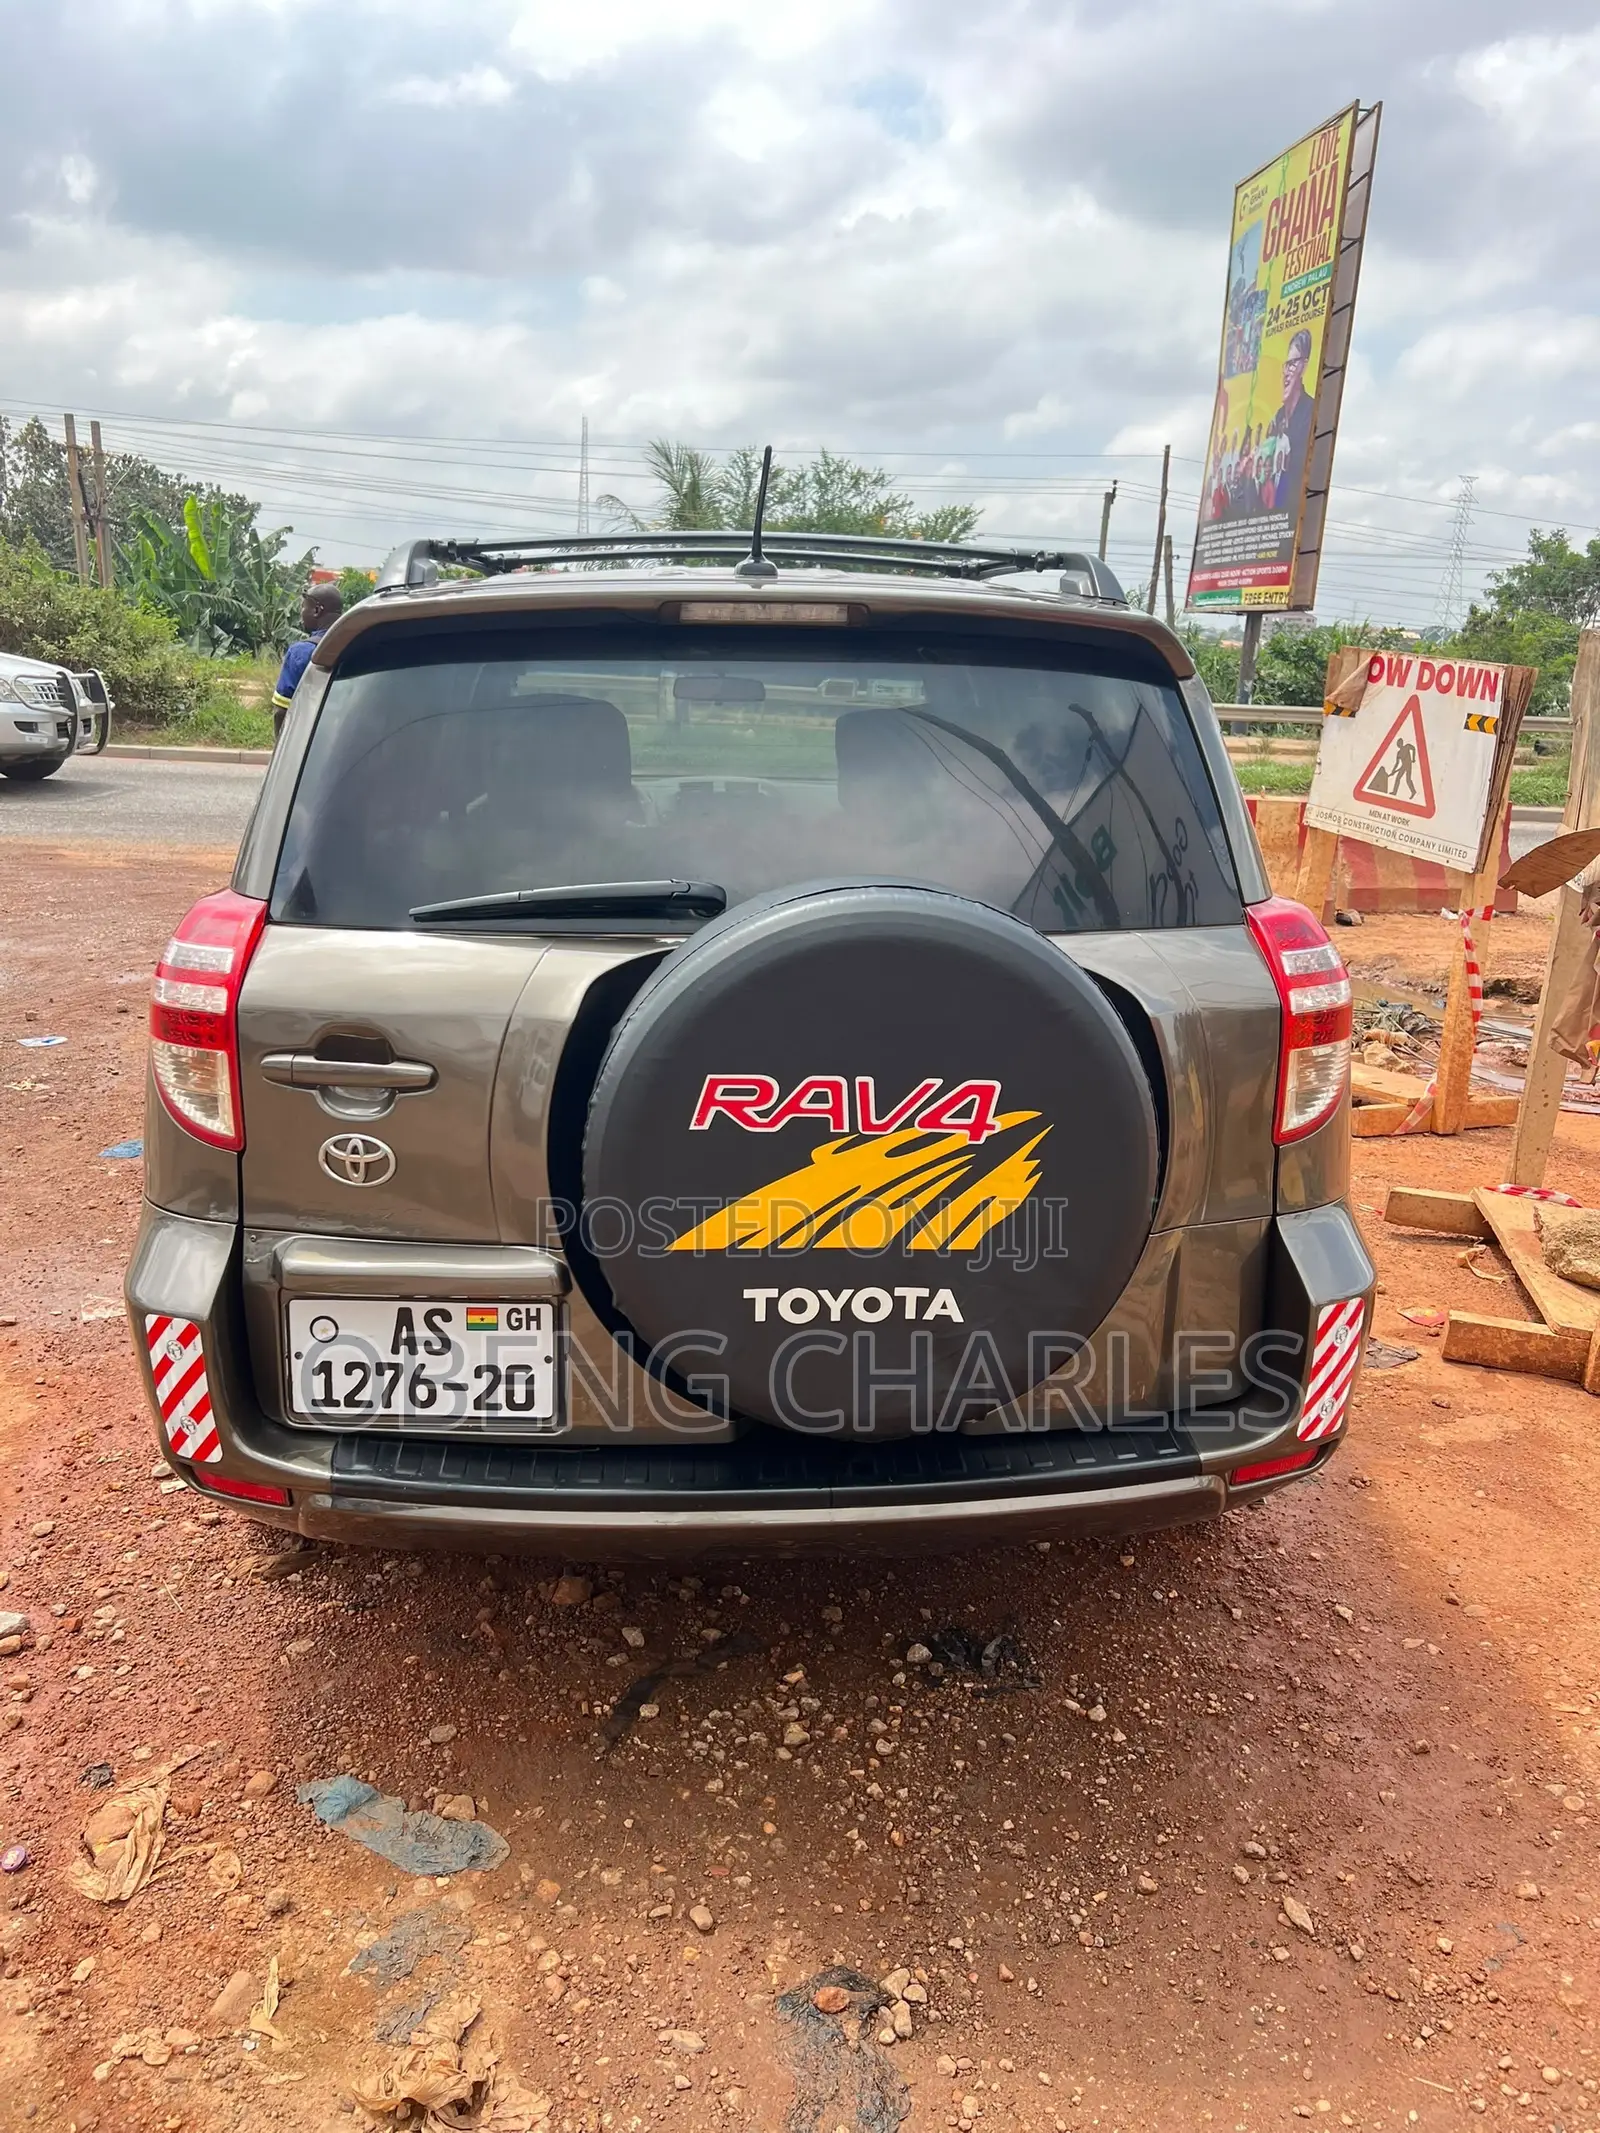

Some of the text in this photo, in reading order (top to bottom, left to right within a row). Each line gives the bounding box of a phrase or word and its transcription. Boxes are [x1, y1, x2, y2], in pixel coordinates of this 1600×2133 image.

[1309, 125, 1341, 176] LOVE
[1262, 160, 1339, 263] GHANA
[1283, 229, 1332, 282] FESTIVAL
[1285, 316, 1300, 331] RACE
[1300, 305, 1325, 324] COURSE
[1302, 282, 1330, 311] OCT
[1244, 592, 1262, 605] FREE
[1263, 591, 1288, 604] ENTRY
[1367, 655, 1499, 703] OW DOWN
[1343, 817, 1397, 838] CONSTRUCTION
[1398, 833, 1437, 850] COMPANY
[1437, 844, 1468, 859] LIMITED
[1368, 809, 1411, 827] MEN AT WORK
[689, 1074, 1001, 1144] RAV4
[743, 1286, 965, 1325] TOYOTA
[390, 1306, 542, 1356] AS GH
[311, 1360, 535, 1412] 1276-20
